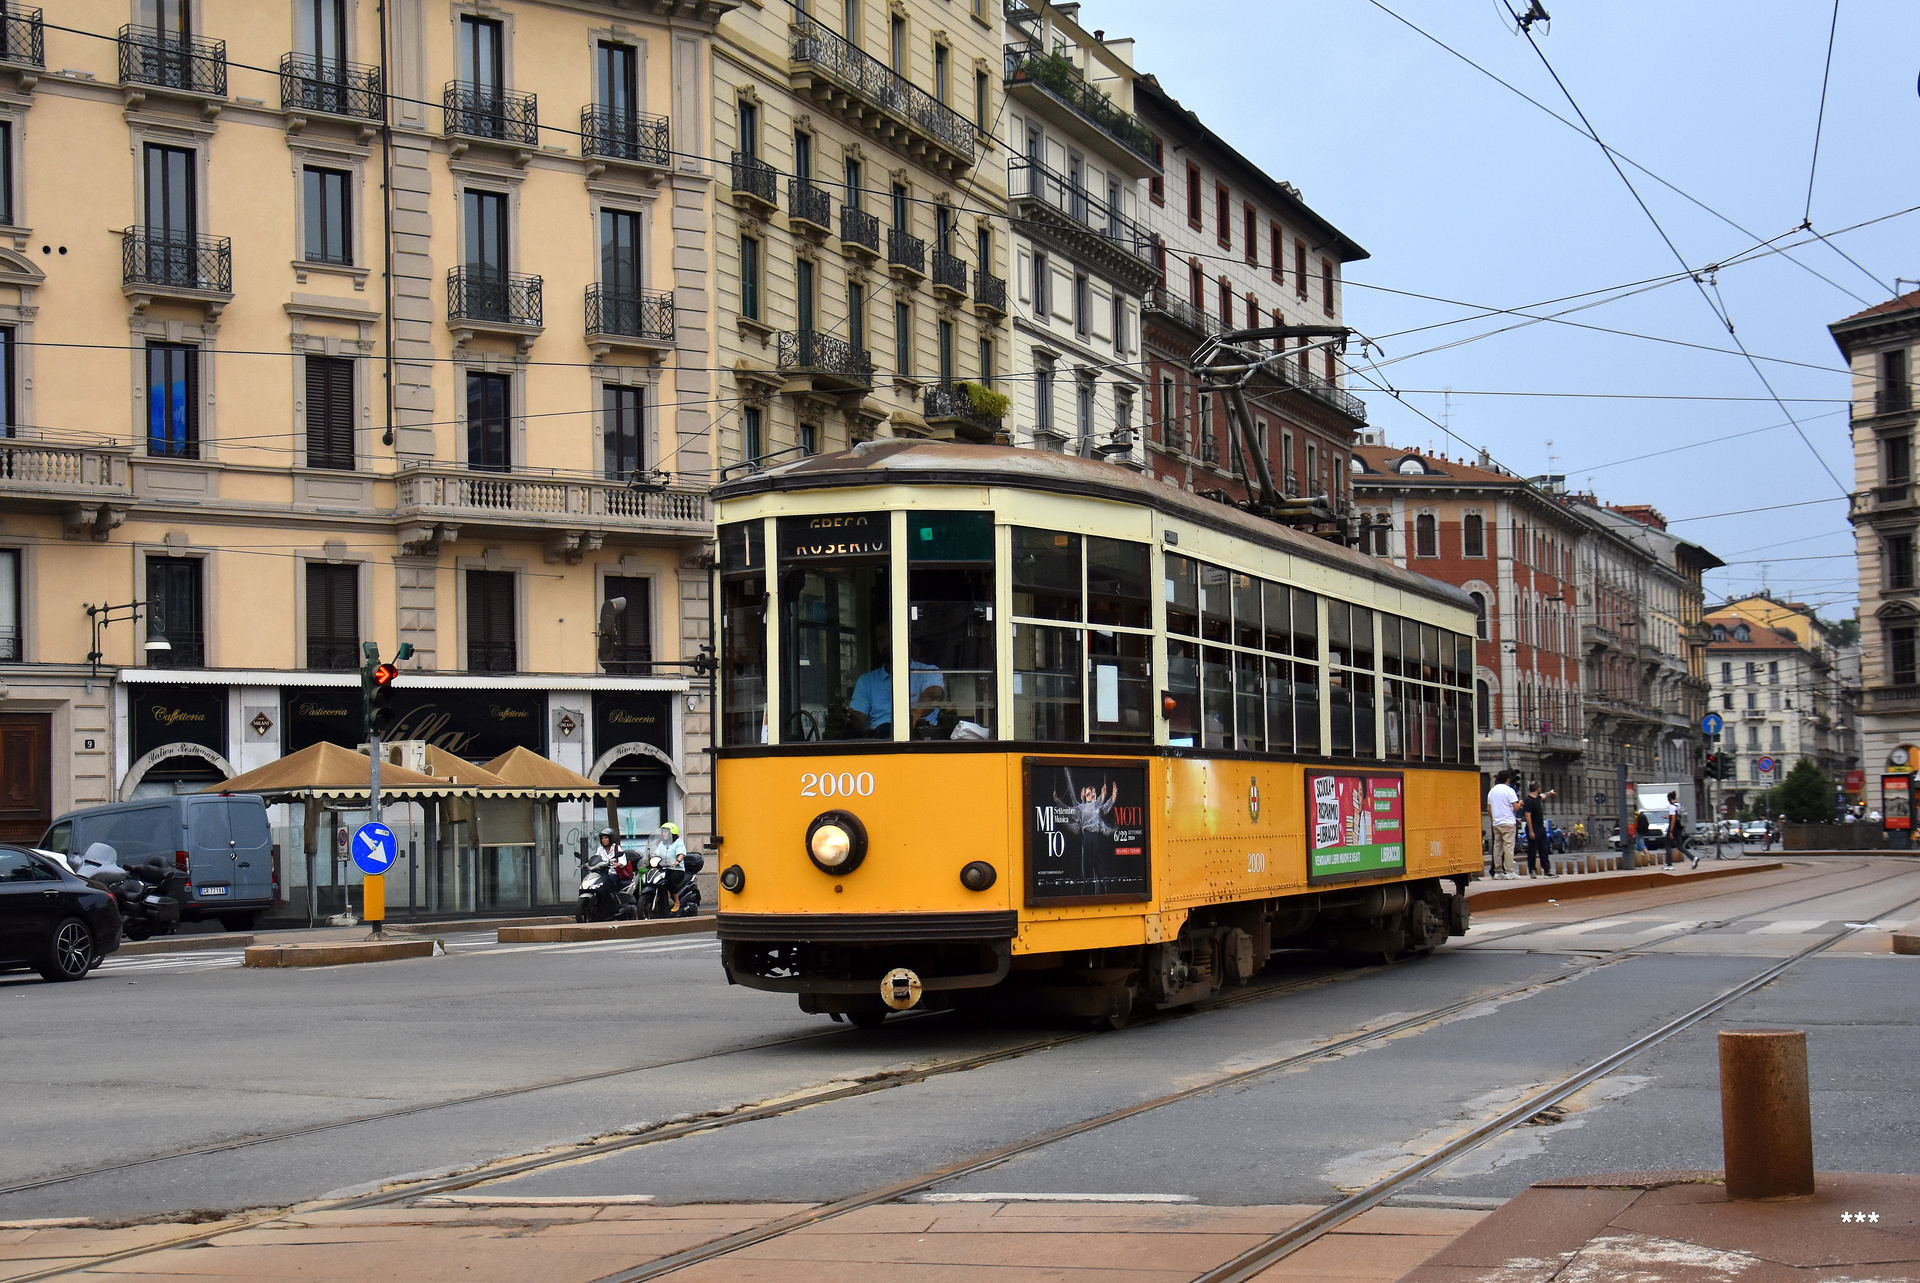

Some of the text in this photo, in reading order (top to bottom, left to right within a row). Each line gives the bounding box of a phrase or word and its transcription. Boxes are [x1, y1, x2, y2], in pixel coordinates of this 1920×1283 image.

[151, 705, 206, 726] Caffetteria
[299, 702, 348, 716] Pasticceria
[608, 709, 656, 724] Pasticceria
[87, 740, 93, 748] 9
[800, 771, 875, 797] 2000
[1035, 806, 1076, 832] MI Settembre
[1318, 802, 1338, 821] RISPARMIO
[1044, 831, 1065, 858] TO
[1113, 830, 1128, 842] 6/22
[1381, 846, 1401, 863] LIBRACCIO
[1430, 841, 1442, 857] 2000
[1247, 853, 1265, 873] 2000
